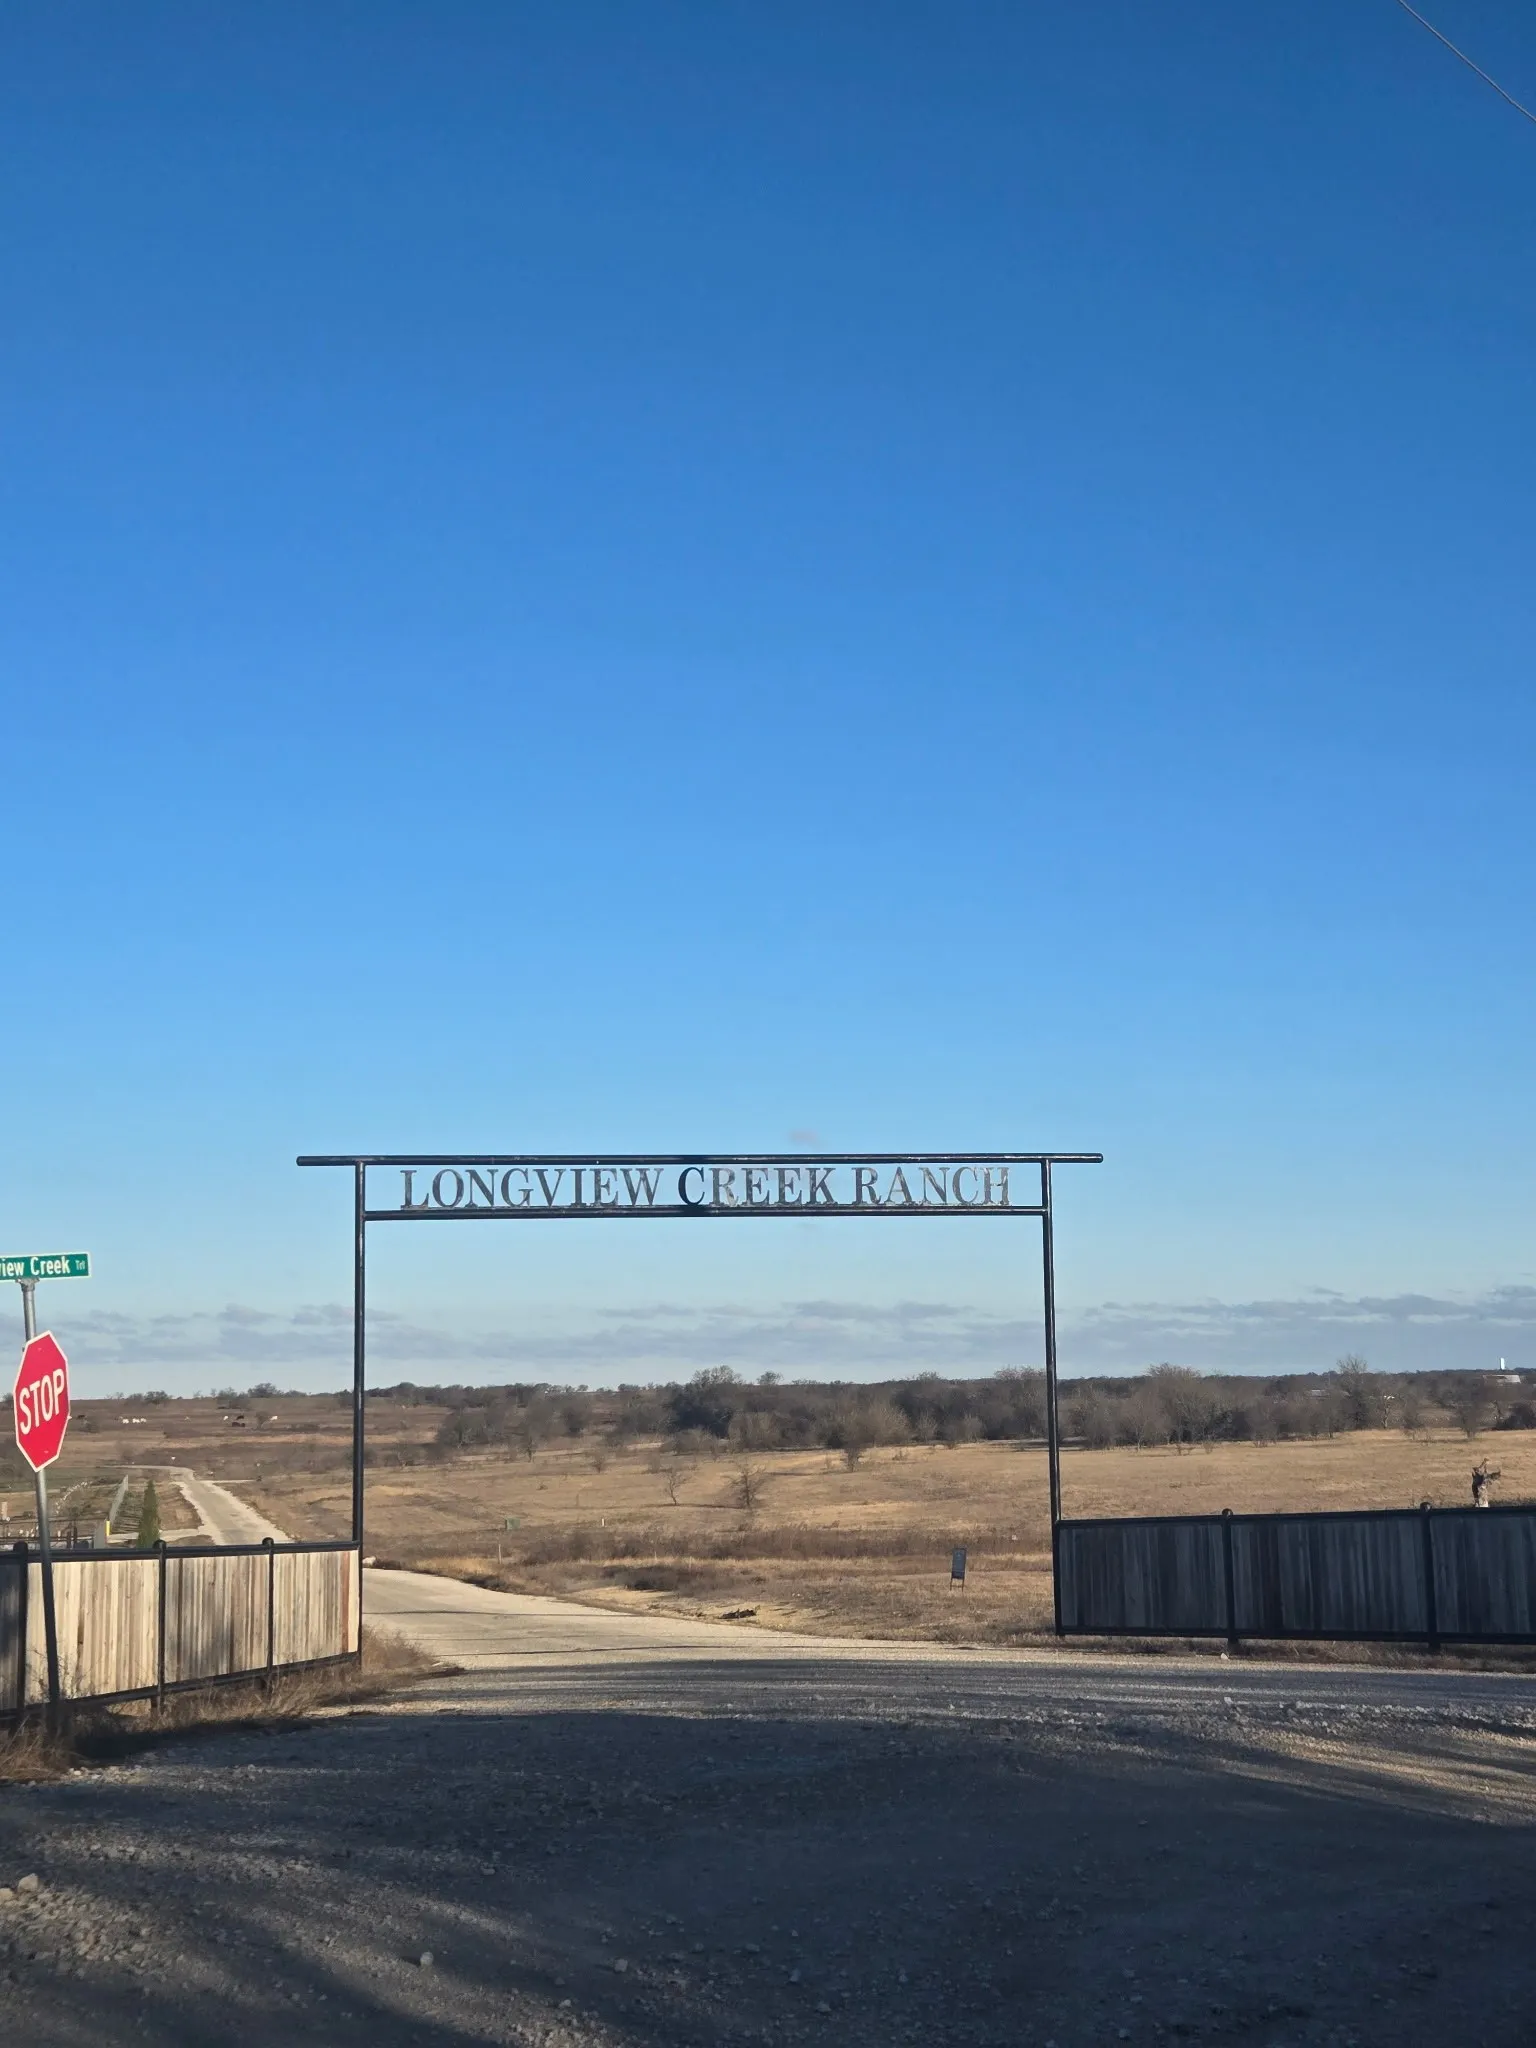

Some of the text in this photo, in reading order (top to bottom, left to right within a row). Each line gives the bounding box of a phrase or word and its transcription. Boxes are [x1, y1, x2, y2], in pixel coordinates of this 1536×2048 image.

[400, 1166, 1012, 1209] LONGVIEW CREEK RANCH
[30, 1255, 71, 1276] Creek
[19, 1368, 65, 1435] STOP
